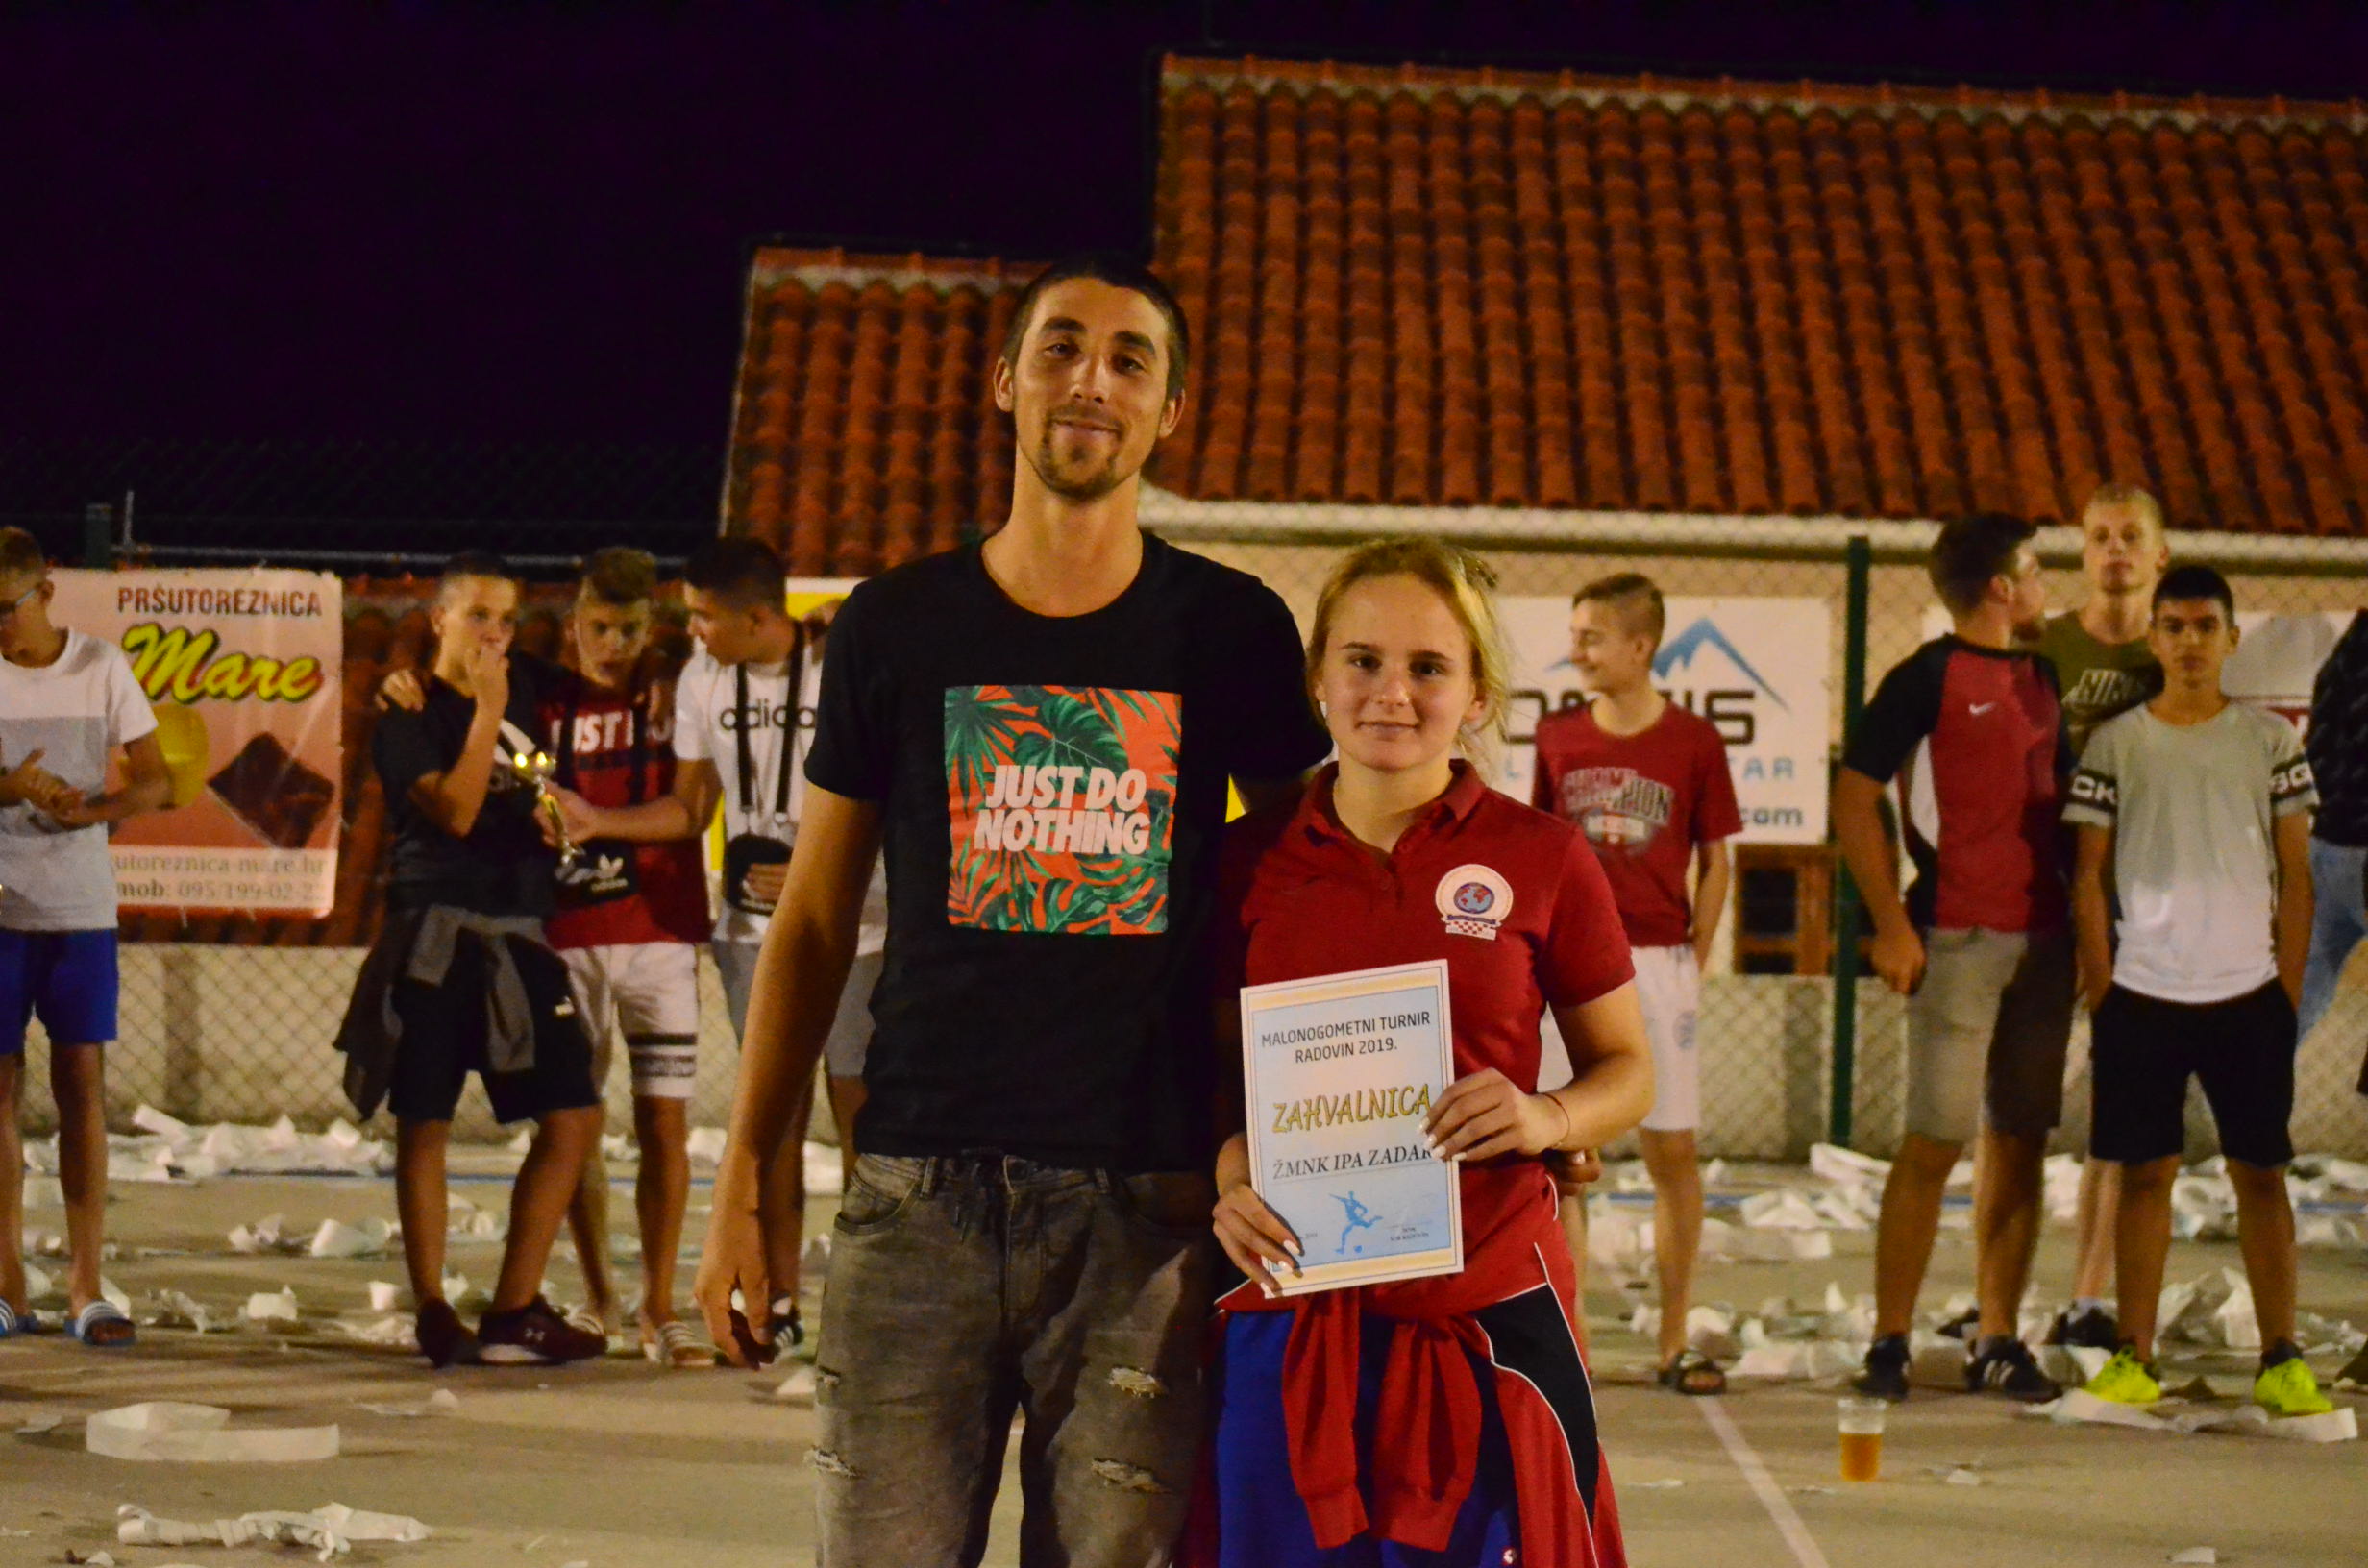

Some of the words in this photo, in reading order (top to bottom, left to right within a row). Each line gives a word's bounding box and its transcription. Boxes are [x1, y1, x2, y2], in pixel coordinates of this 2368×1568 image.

[118, 583, 322, 617] PRŠUTOREZNICA
[122, 622, 325, 705] Mare
[985, 765, 1084, 808] JUST
[1085, 768, 1147, 811] DO
[974, 808, 1150, 854] NOTHING
[1261, 1018, 1375, 1047] MALONOGOMETNI
[1379, 1011, 1431, 1031] TURNIR
[1295, 1042, 1354, 1064] RADOVIN
[1359, 1037, 1397, 1054] 2019.
[1271, 1083, 1432, 1133] ZAHVALNICA
[1273, 1155, 1328, 1180] ŽMNK
[1333, 1152, 1363, 1171] IPA
